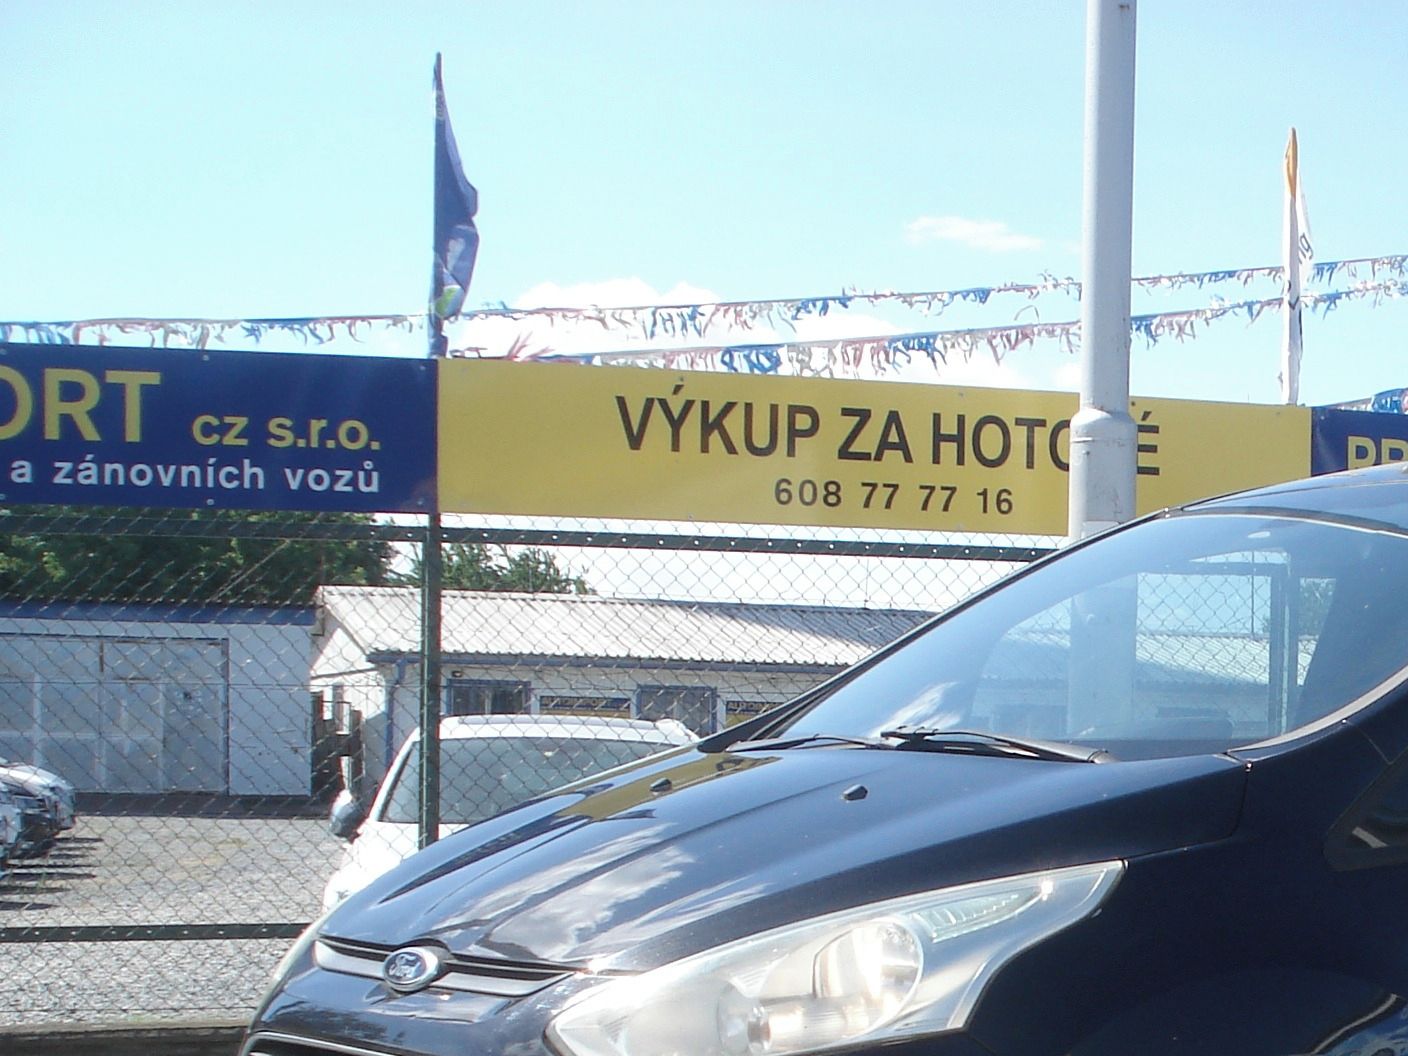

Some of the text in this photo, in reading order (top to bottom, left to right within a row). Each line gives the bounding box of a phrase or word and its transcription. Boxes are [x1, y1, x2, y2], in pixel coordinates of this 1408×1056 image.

[192, 415, 248, 446] cz
[267, 417, 381, 450] s.r.o.
[615, 384, 1160, 476] VÝKUP ZA HOTOÉ
[10, 454, 379, 493] a zánovních vozů
[775, 478, 1013, 514] 608 77 77 16
